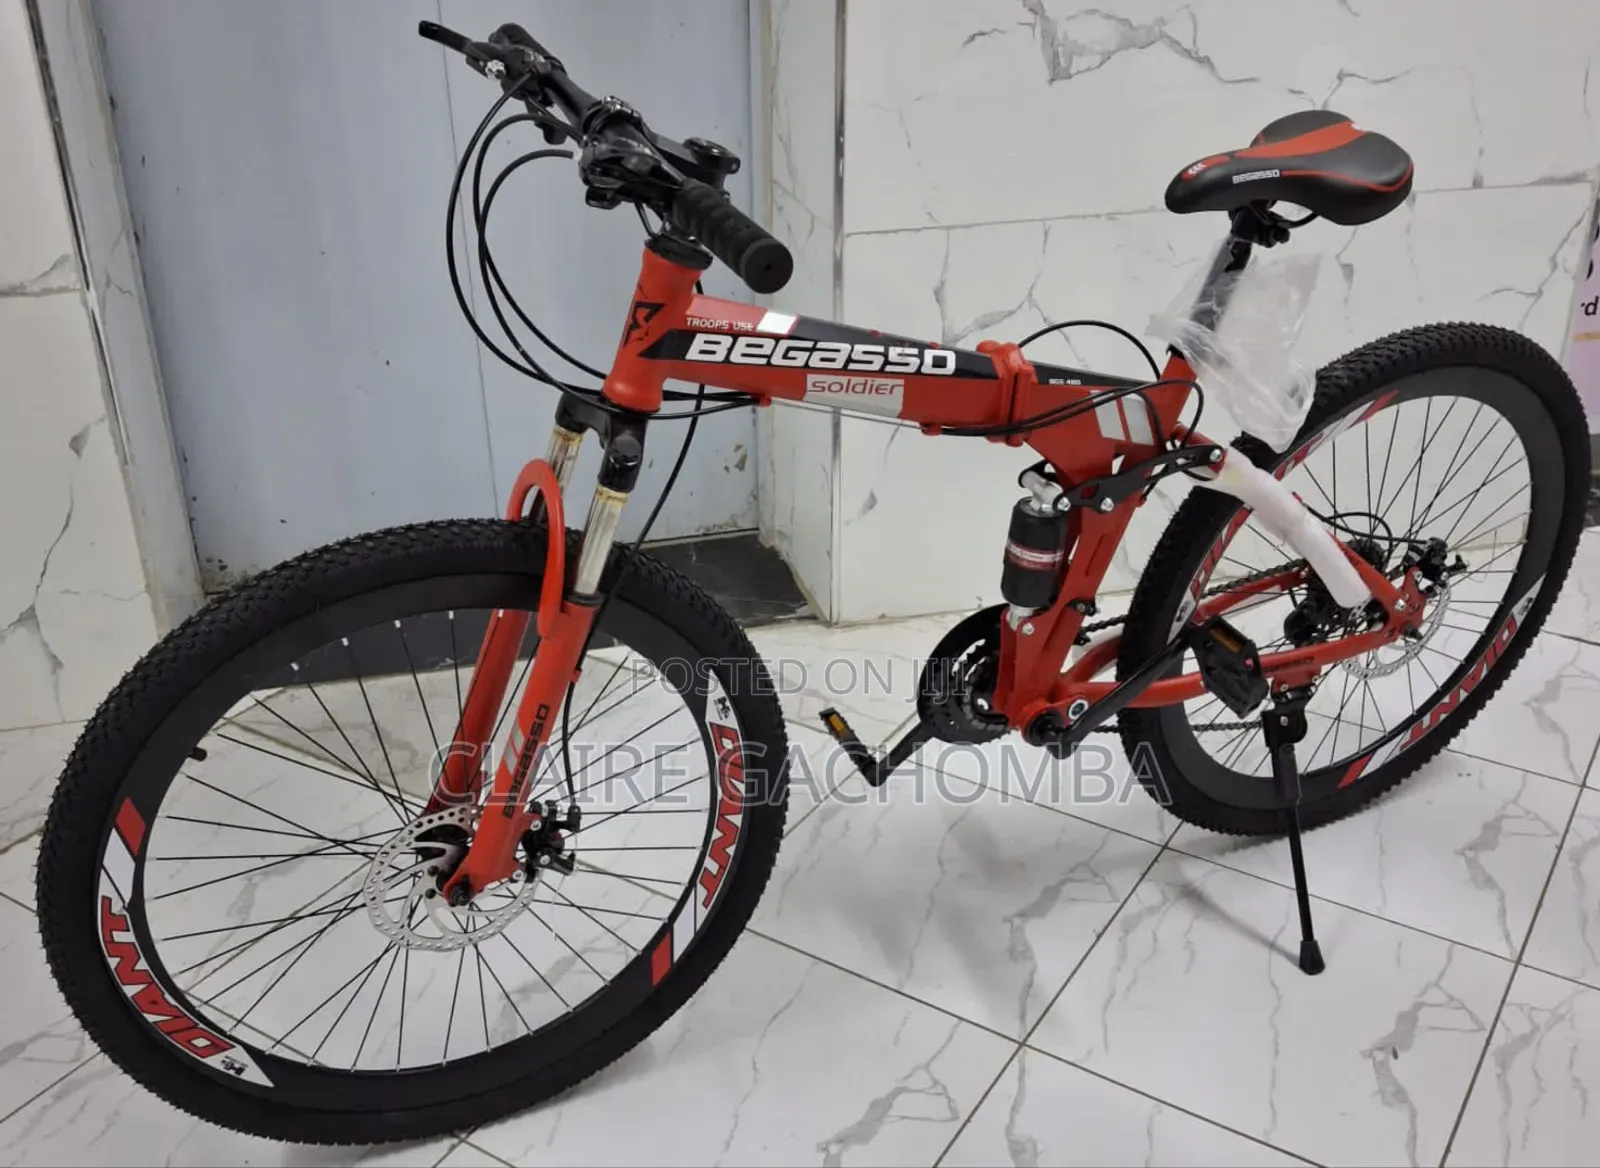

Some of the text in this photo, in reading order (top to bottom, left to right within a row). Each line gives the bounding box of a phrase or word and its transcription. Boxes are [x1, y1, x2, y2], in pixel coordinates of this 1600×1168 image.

[686, 317, 754, 331] TROOPS USE
[807, 379, 904, 397] soldier
